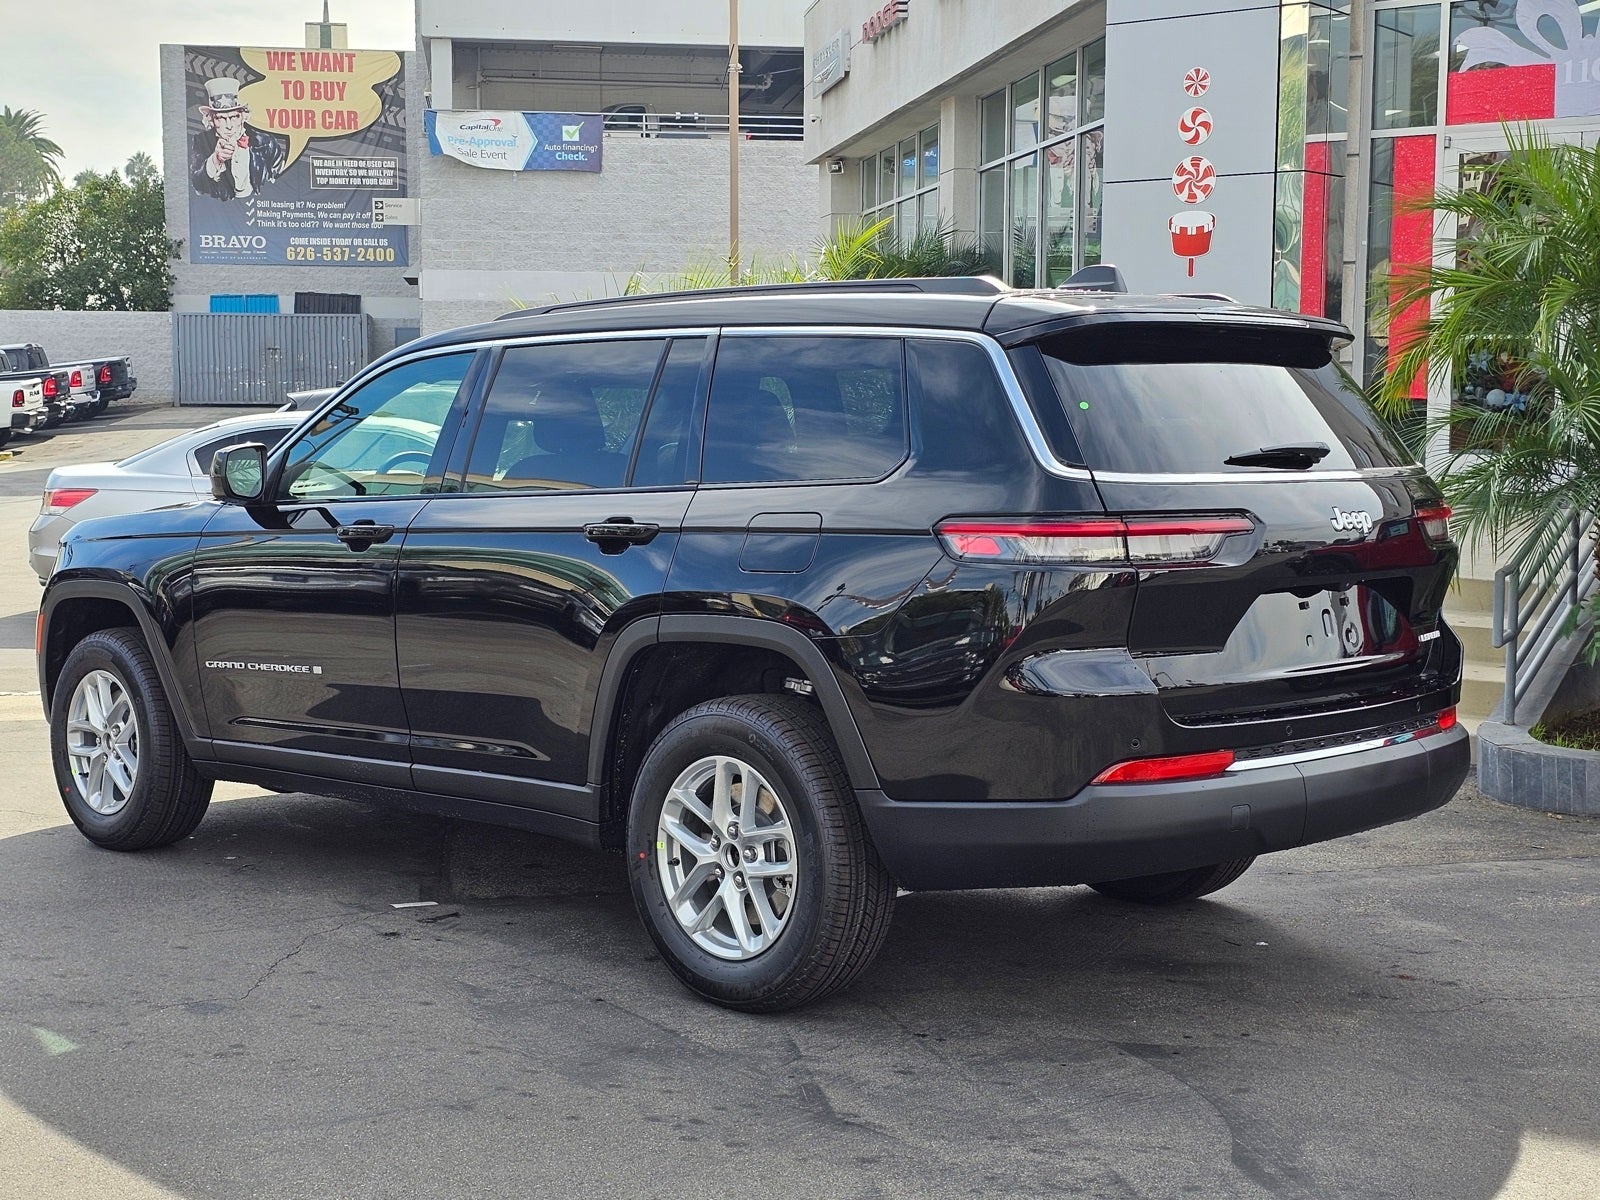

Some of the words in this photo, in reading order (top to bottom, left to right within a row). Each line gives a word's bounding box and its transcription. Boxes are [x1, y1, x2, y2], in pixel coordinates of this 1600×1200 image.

[266, 51, 296, 71] WE
[300, 52, 356, 72] WANT
[281, 80, 305, 100] TO
[310, 80, 347, 101] BUY
[266, 109, 318, 129] YOUR
[322, 110, 358, 130] CAR
[448, 135, 516, 148] Pre-Approval
[458, 146, 478, 158] Sale
[480, 149, 508, 160] Event
[562, 144, 598, 153] financing?
[556, 152, 588, 160] Check.
[271, 200, 294, 209] leasing
[257, 210, 280, 219] Making
[282, 211, 316, 220] Payments,
[200, 235, 266, 248] BRAVO
[290, 237, 308, 245] COME
[286, 246, 394, 262] 626-537-2400
[1330, 506, 1373, 536] Jeep
[205, 660, 246, 670] GRAND
[247, 662, 310, 673] CHEROKEE
